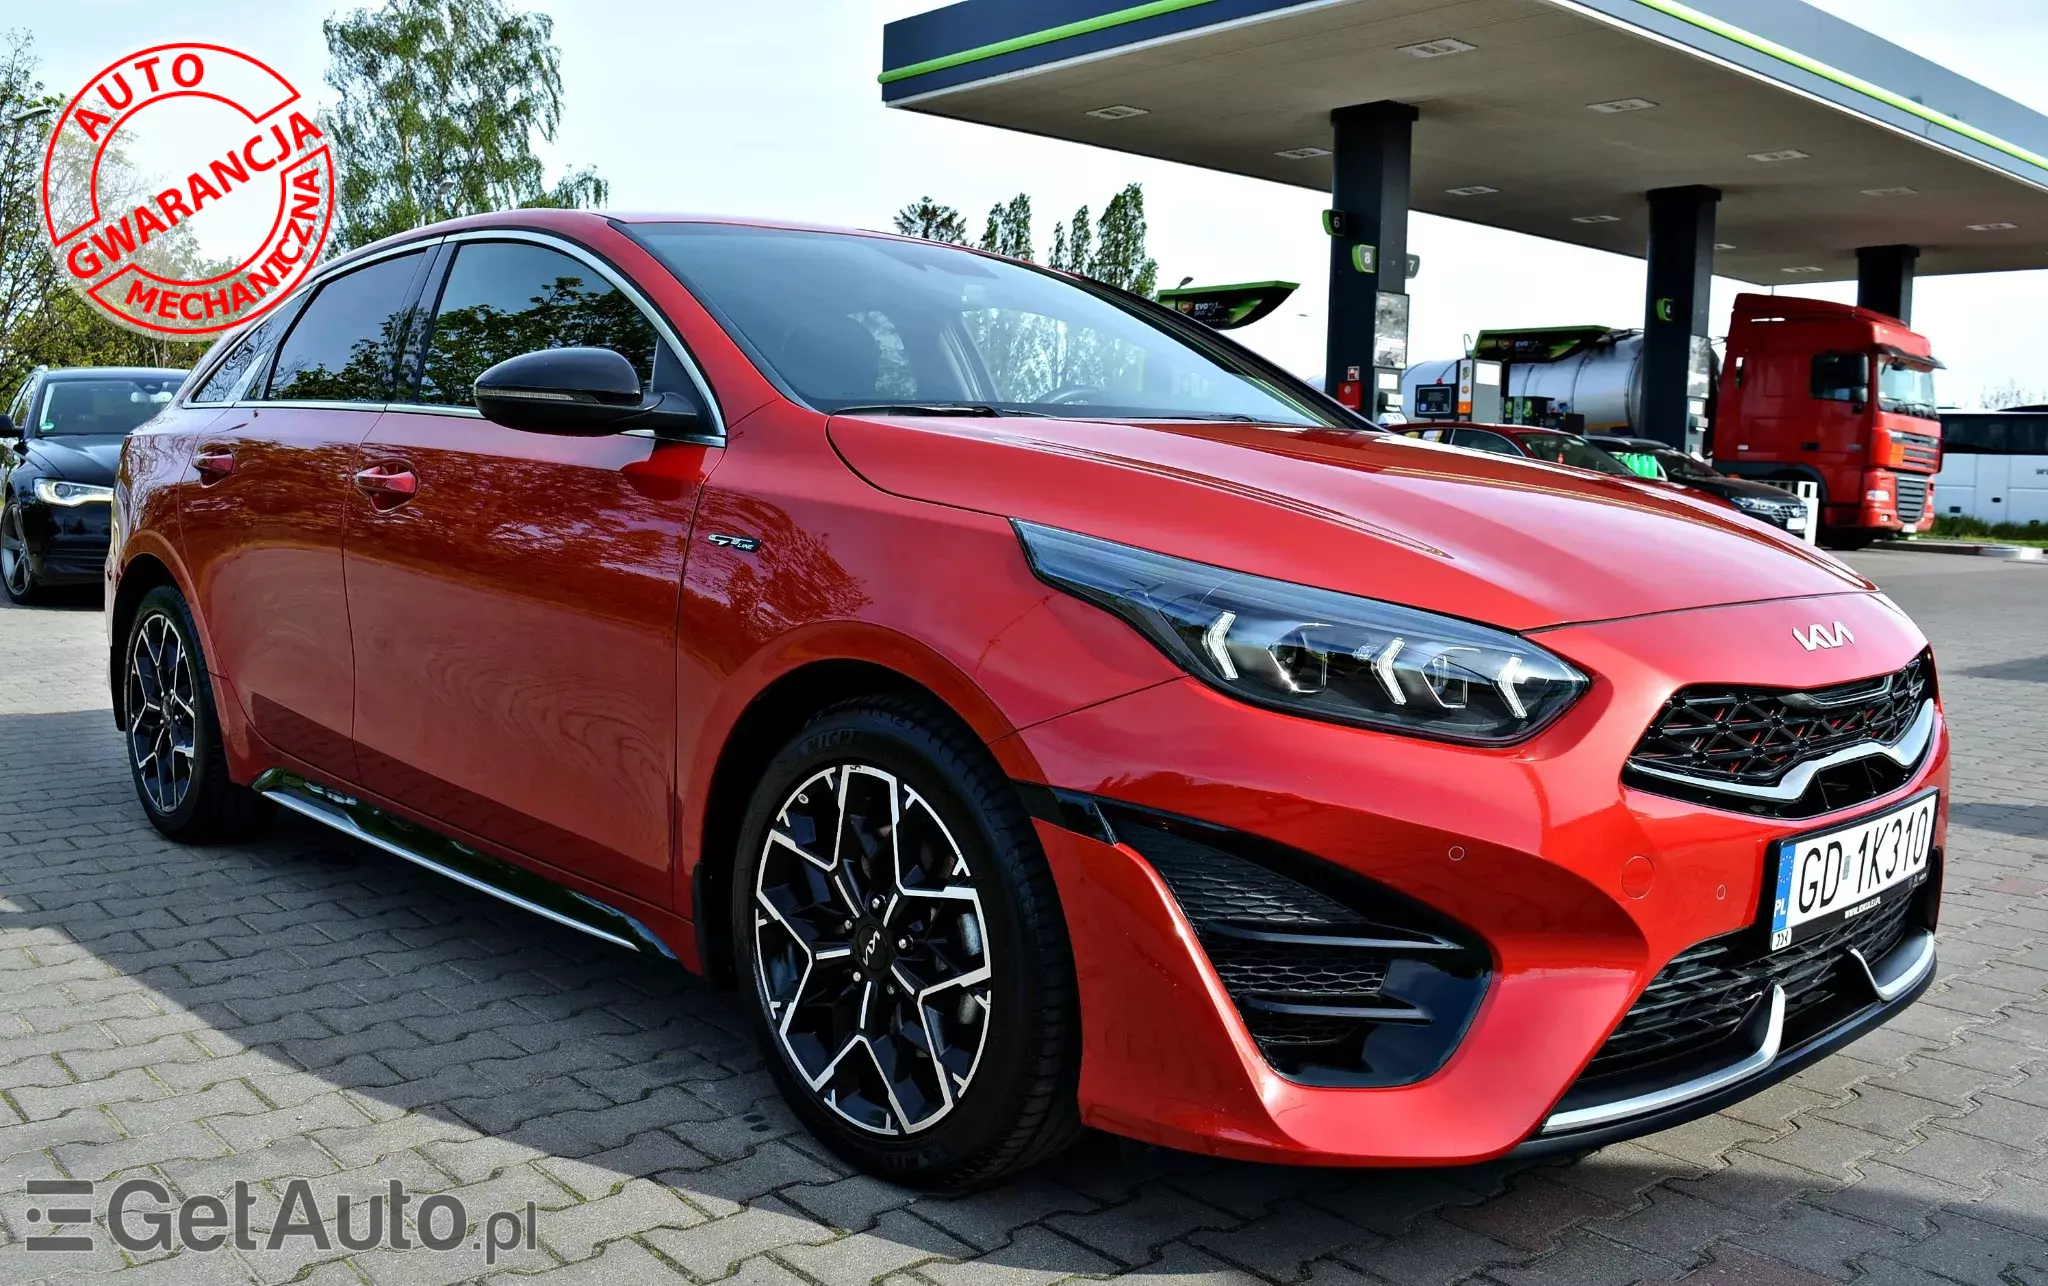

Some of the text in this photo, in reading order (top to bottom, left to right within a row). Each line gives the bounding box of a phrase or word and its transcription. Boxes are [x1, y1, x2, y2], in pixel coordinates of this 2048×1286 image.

[1333, 217, 1340, 228] 6
[1364, 252, 1371, 264] 8
[1408, 260, 1416, 271] 7
[1194, 303, 1208, 311] EVO
[1792, 620, 1855, 652] KIA
[1798, 806, 1929, 914] GD 1K310
[1774, 897, 1786, 918] PL
